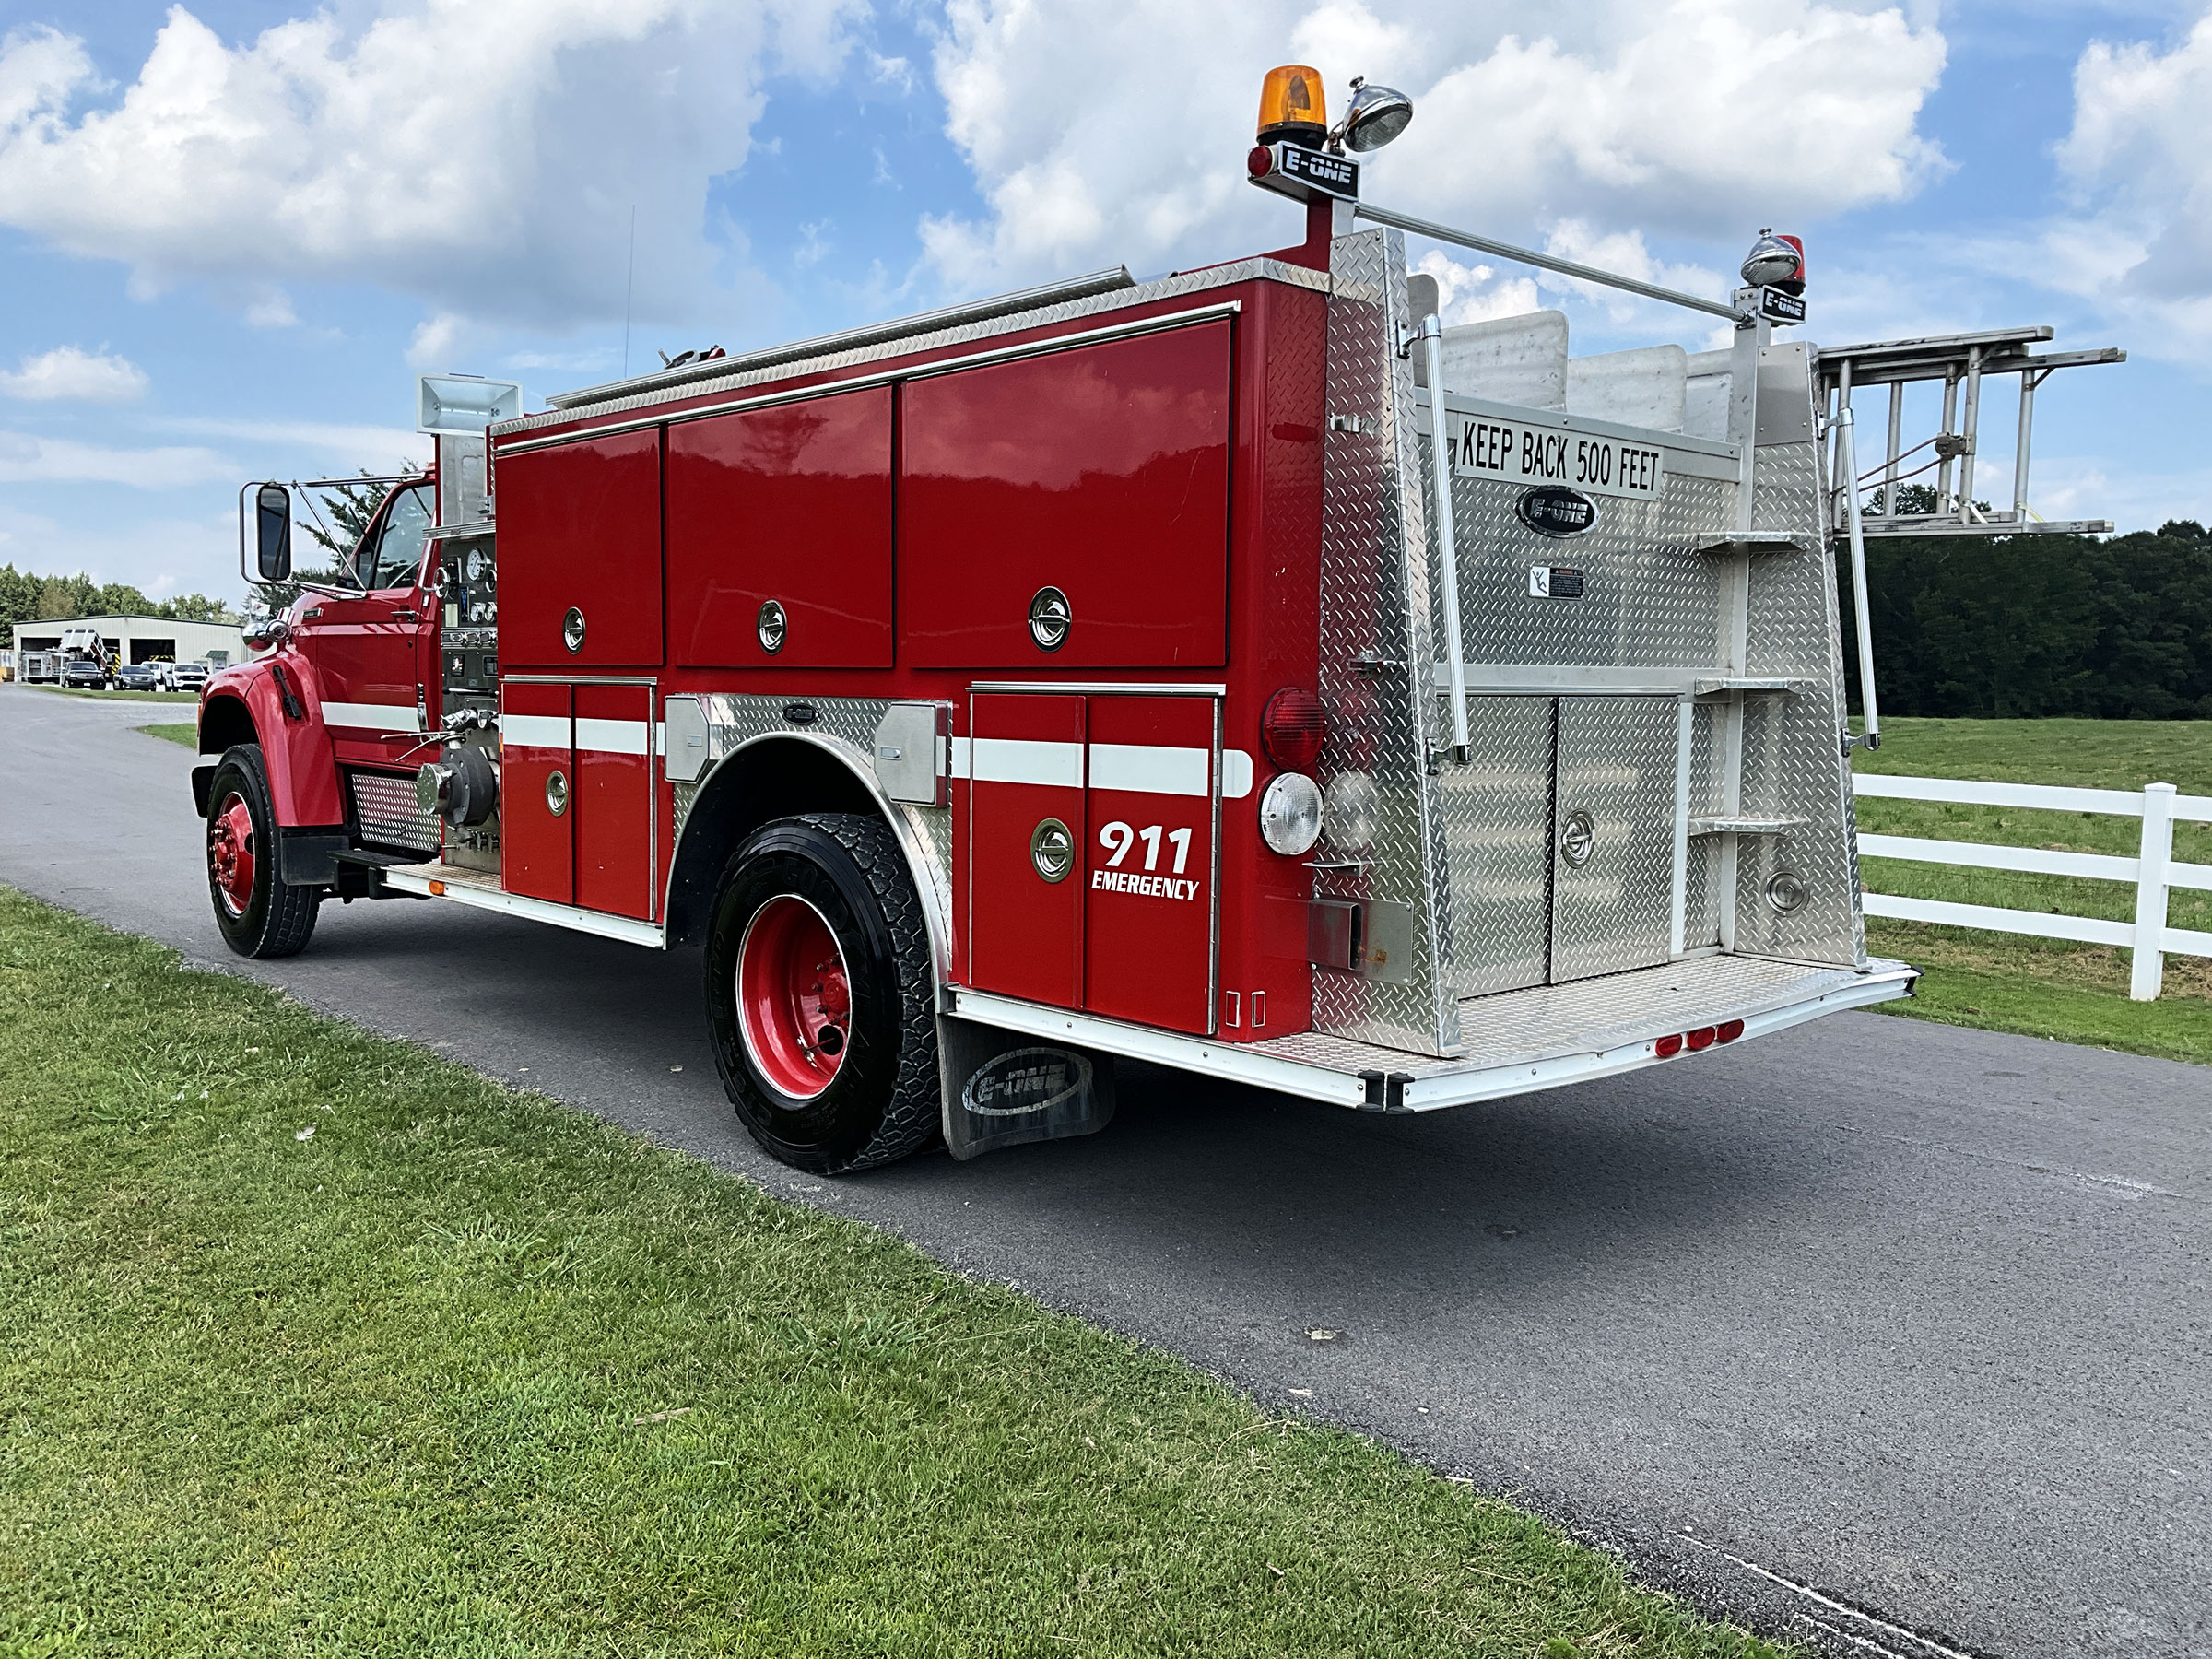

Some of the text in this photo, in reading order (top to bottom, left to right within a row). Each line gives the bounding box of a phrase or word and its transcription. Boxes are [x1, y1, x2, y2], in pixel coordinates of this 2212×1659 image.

[1286, 149, 1352, 184] E-ONE
[1765, 291, 1804, 317] E-ONE
[1462, 420, 1659, 492] KEEP BACK 500 FEET
[1531, 498, 1588, 524] E-ONE
[1099, 820, 1193, 875] 911
[1091, 869, 1200, 901] EMERGENCY
